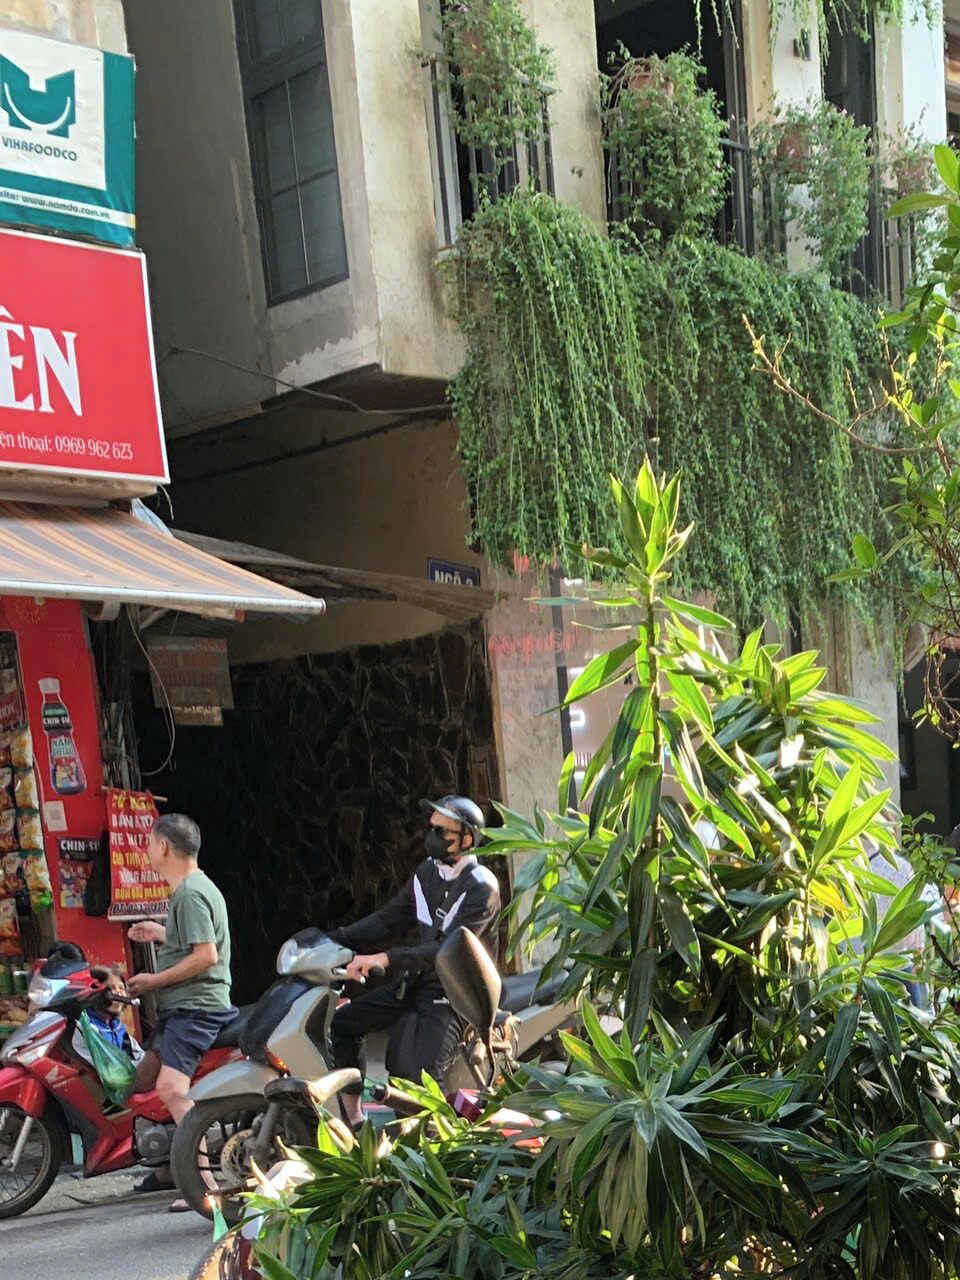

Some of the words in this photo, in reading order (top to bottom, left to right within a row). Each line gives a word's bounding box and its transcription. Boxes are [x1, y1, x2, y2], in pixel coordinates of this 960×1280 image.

[2, 136, 78, 161] VIHAFOODCO
[22, 195, 110, 219] www.namdo.com.vn
[17, 431, 52, 454] thoại:
[55, 435, 85, 455] 0969
[88, 438, 110, 460] 962
[112, 442, 134, 461] 623
